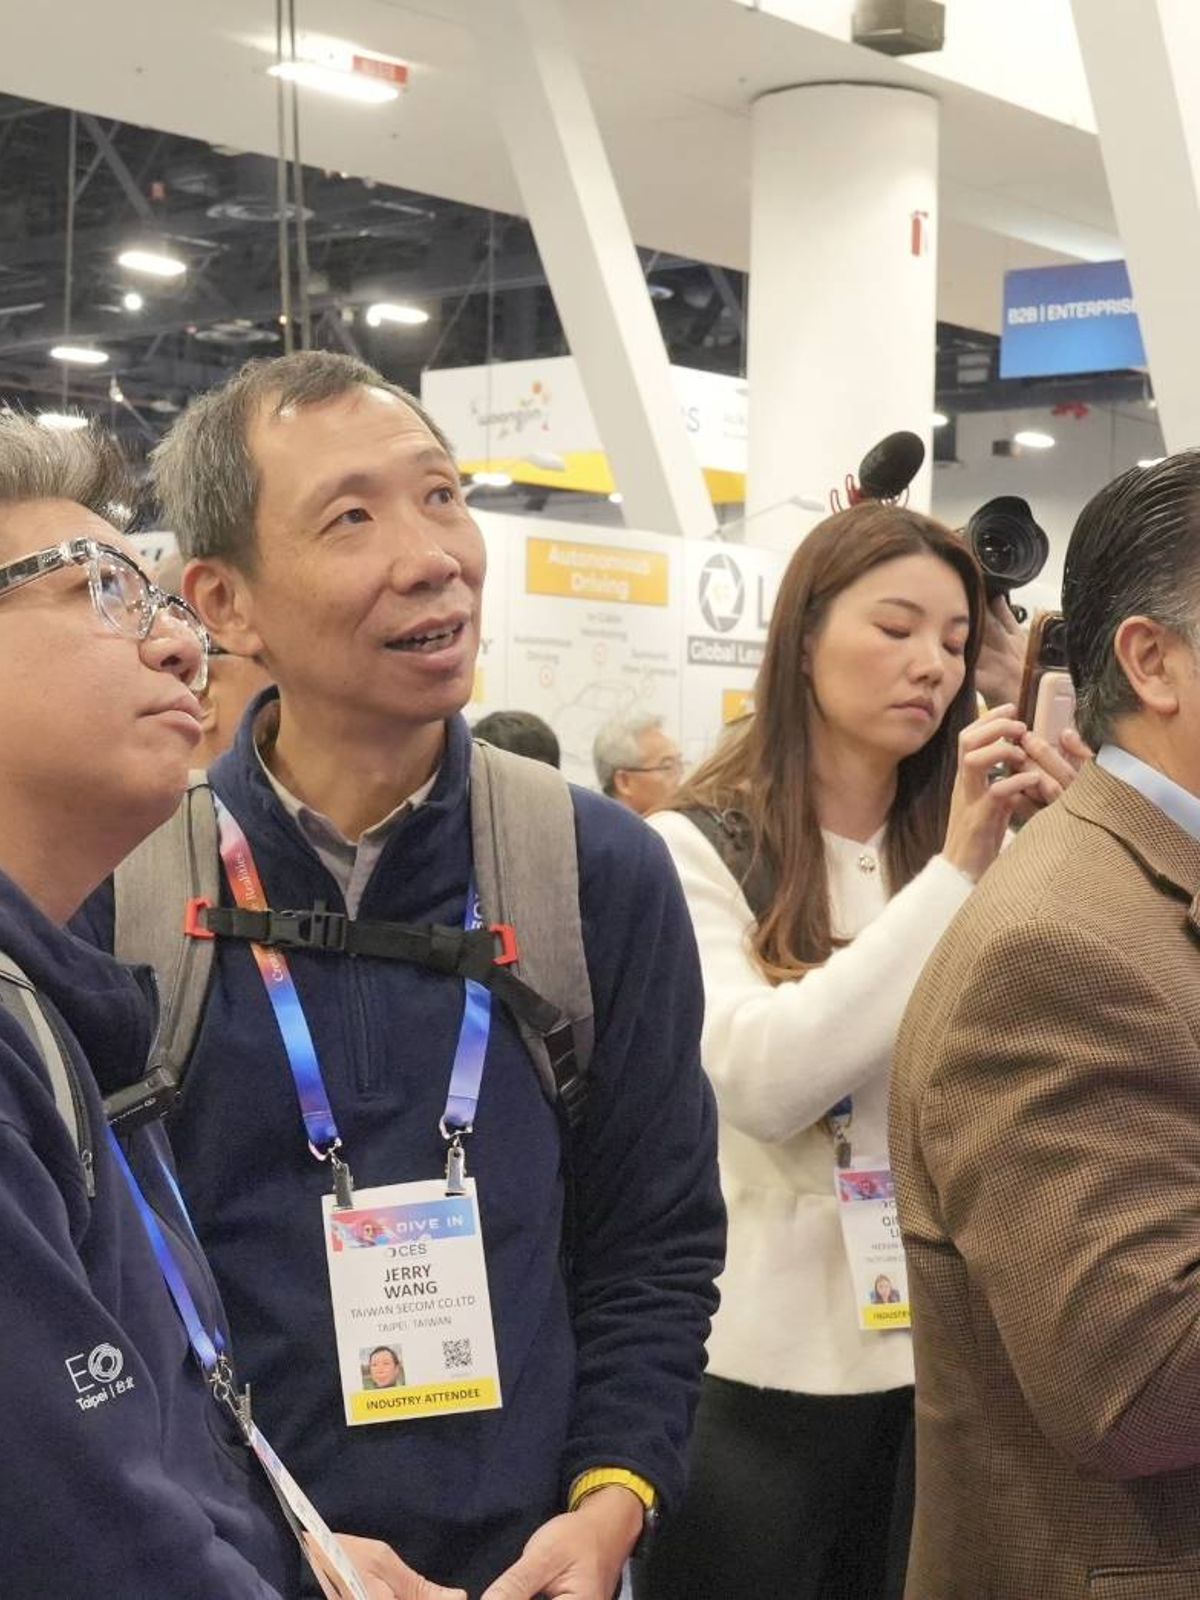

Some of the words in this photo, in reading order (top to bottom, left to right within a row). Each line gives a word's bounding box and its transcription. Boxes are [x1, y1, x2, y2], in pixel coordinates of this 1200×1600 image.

[397, 1217, 440, 1233] DIVE
[447, 1213, 463, 1228] IN
[384, 1264, 431, 1282] JERRY
[383, 1280, 438, 1299] WANG
[350, 1303, 394, 1319] TAIWAN
[75, 1387, 109, 1411] Taipei
[366, 1395, 421, 1410] INDUSTRY
[424, 1388, 481, 1404] ATTENDEE
